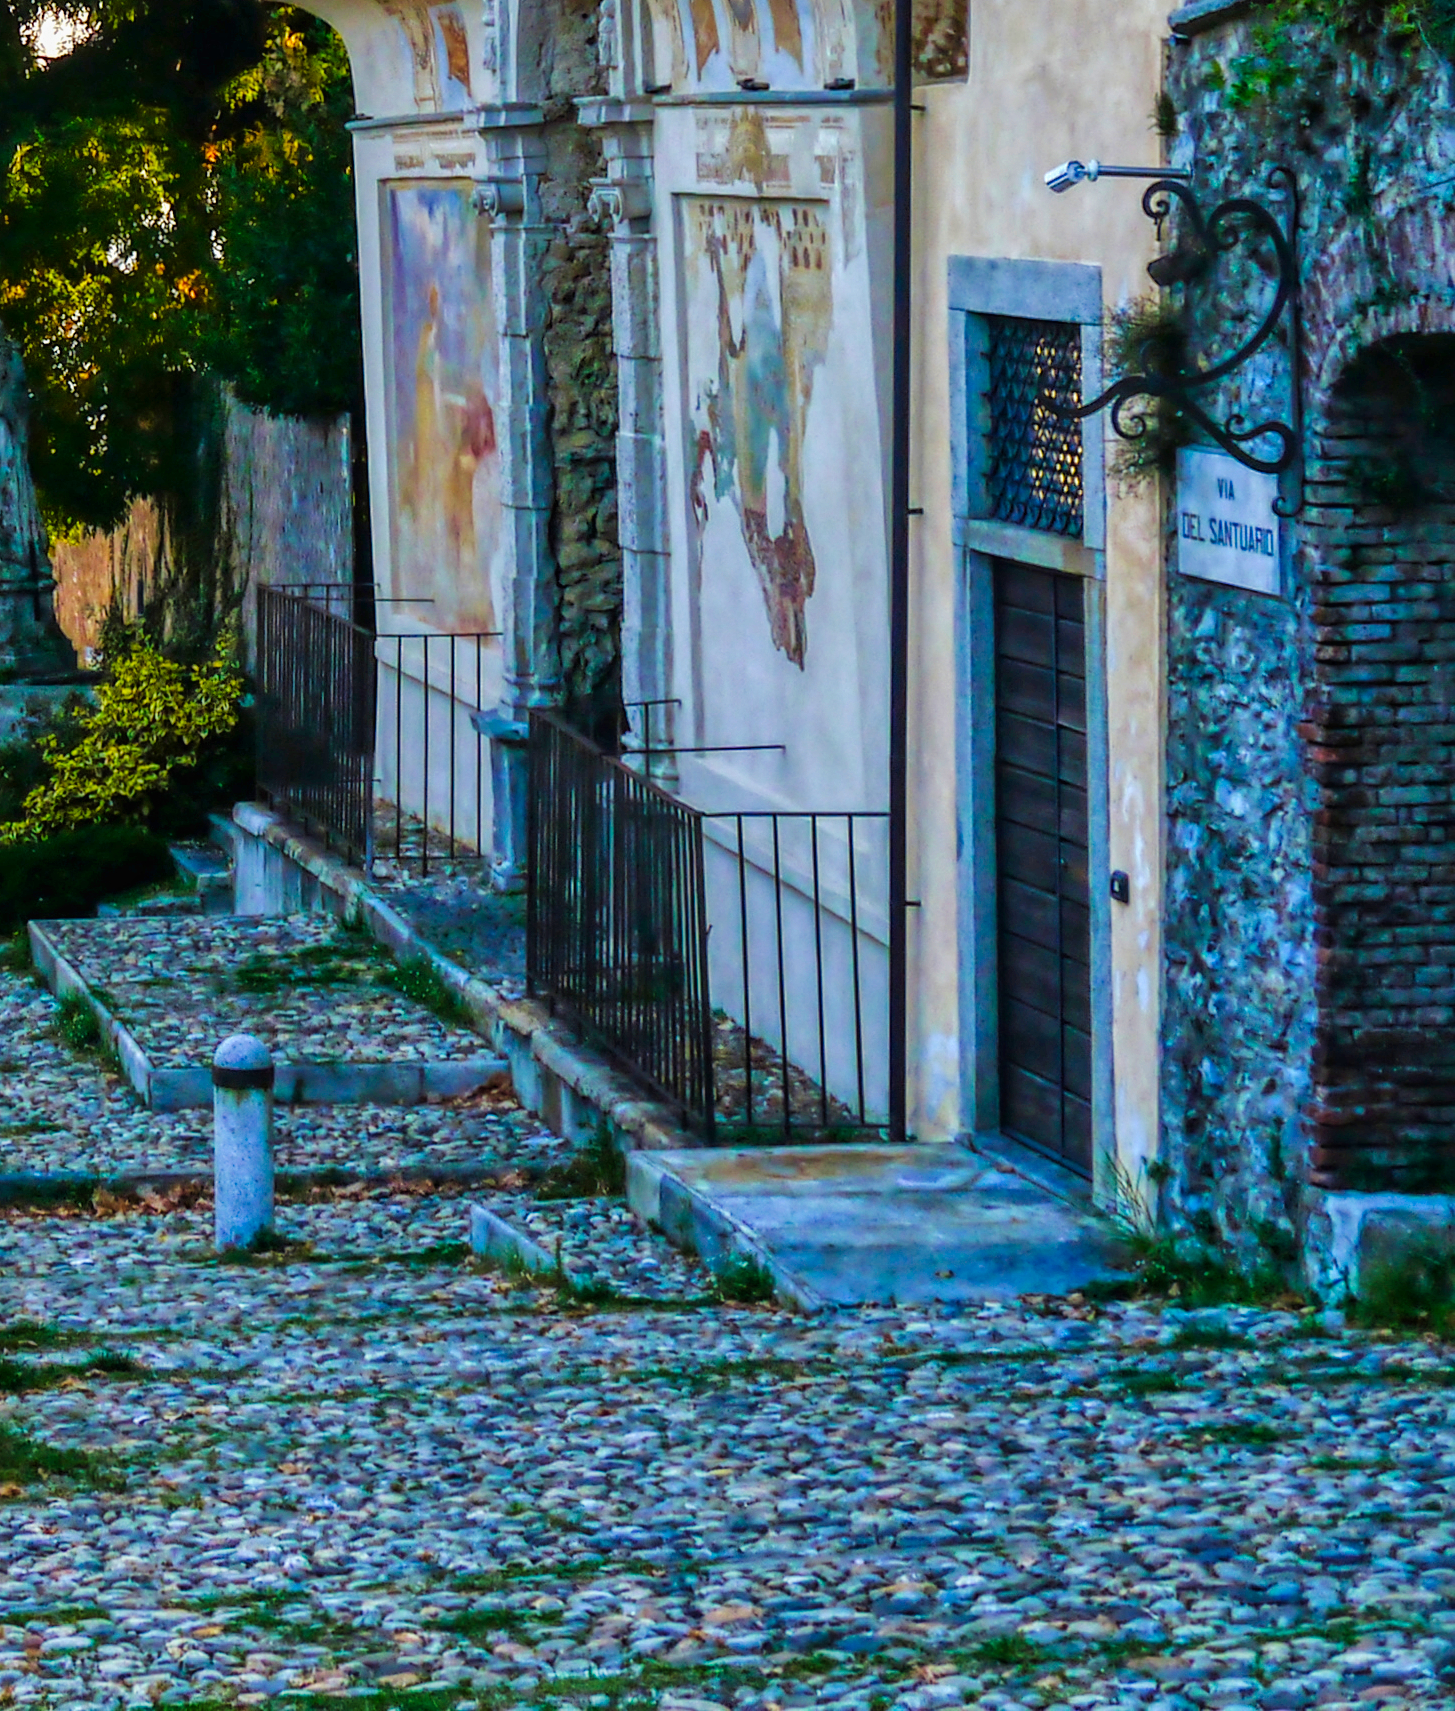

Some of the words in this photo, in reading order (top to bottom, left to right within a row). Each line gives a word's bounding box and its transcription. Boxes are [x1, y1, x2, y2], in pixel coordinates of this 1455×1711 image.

[1217, 478, 1235, 501] VIA
[1182, 512, 1205, 542] DEL
[1209, 518, 1274, 557] SANTUARIO
